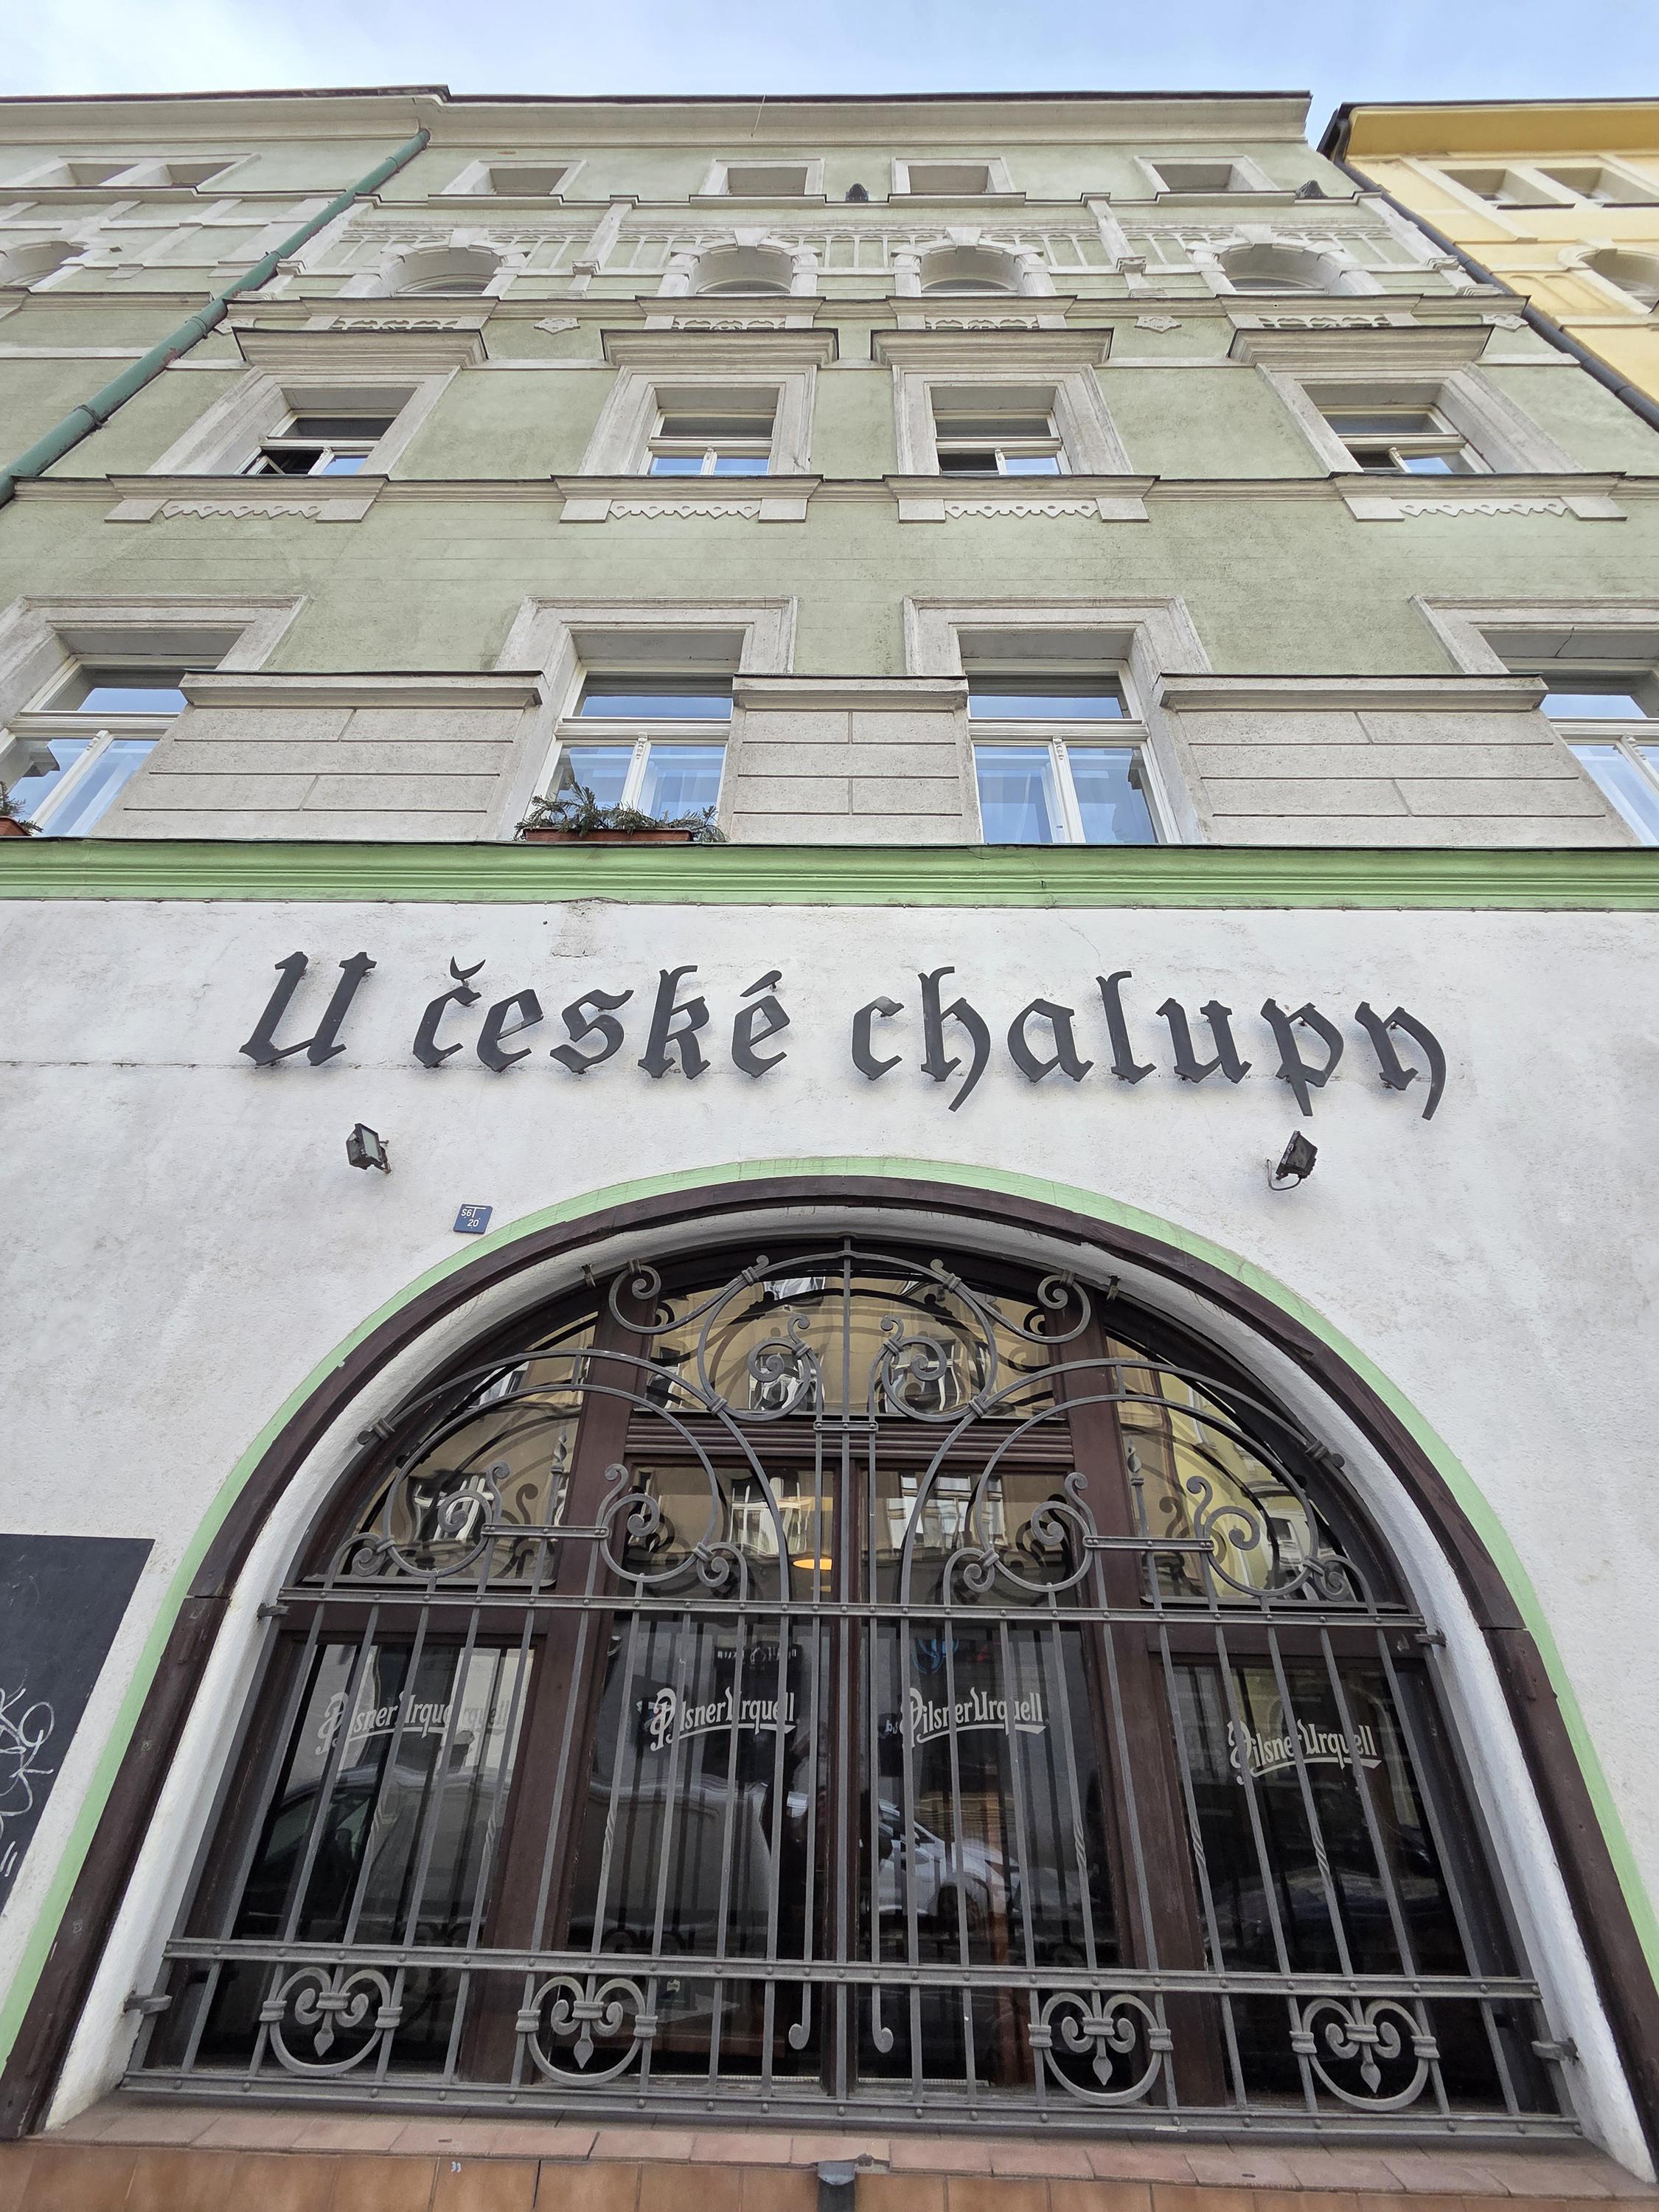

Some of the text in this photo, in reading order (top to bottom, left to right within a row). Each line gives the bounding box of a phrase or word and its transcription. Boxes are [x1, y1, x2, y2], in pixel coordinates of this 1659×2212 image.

[239, 951, 1446, 1120] U české chalupy
[467, 1219, 479, 1227] 20
